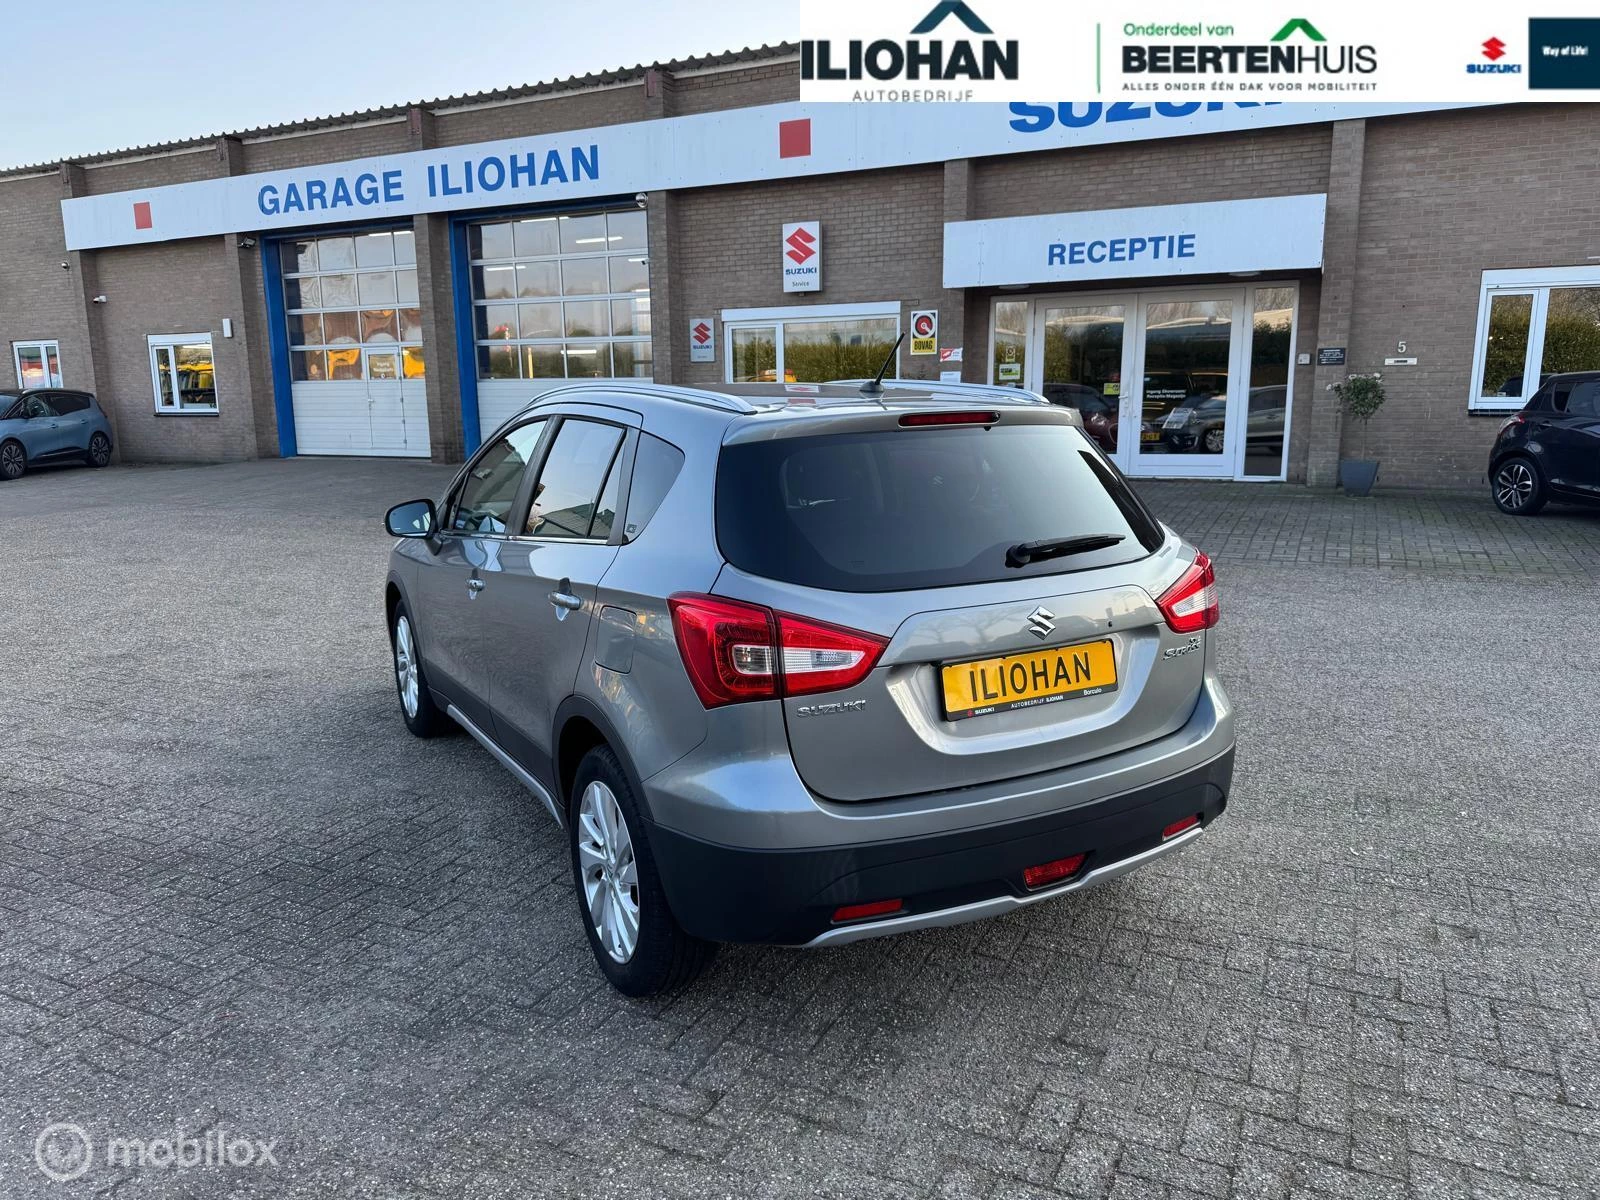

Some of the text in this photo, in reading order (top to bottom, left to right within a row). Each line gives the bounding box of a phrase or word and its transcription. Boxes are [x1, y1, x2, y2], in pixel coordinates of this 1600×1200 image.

[257, 144, 600, 216] GARAGE ILIOHAN
[1048, 234, 1196, 266] RECEPTIE
[785, 267, 818, 276] SUZUKI
[914, 340, 934, 351] BOVAG
[1397, 341, 1407, 353] 5
[969, 651, 1091, 702] ILIOHAN
[797, 699, 866, 718] SUZUKI
[974, 706, 995, 716] SUZUKI
